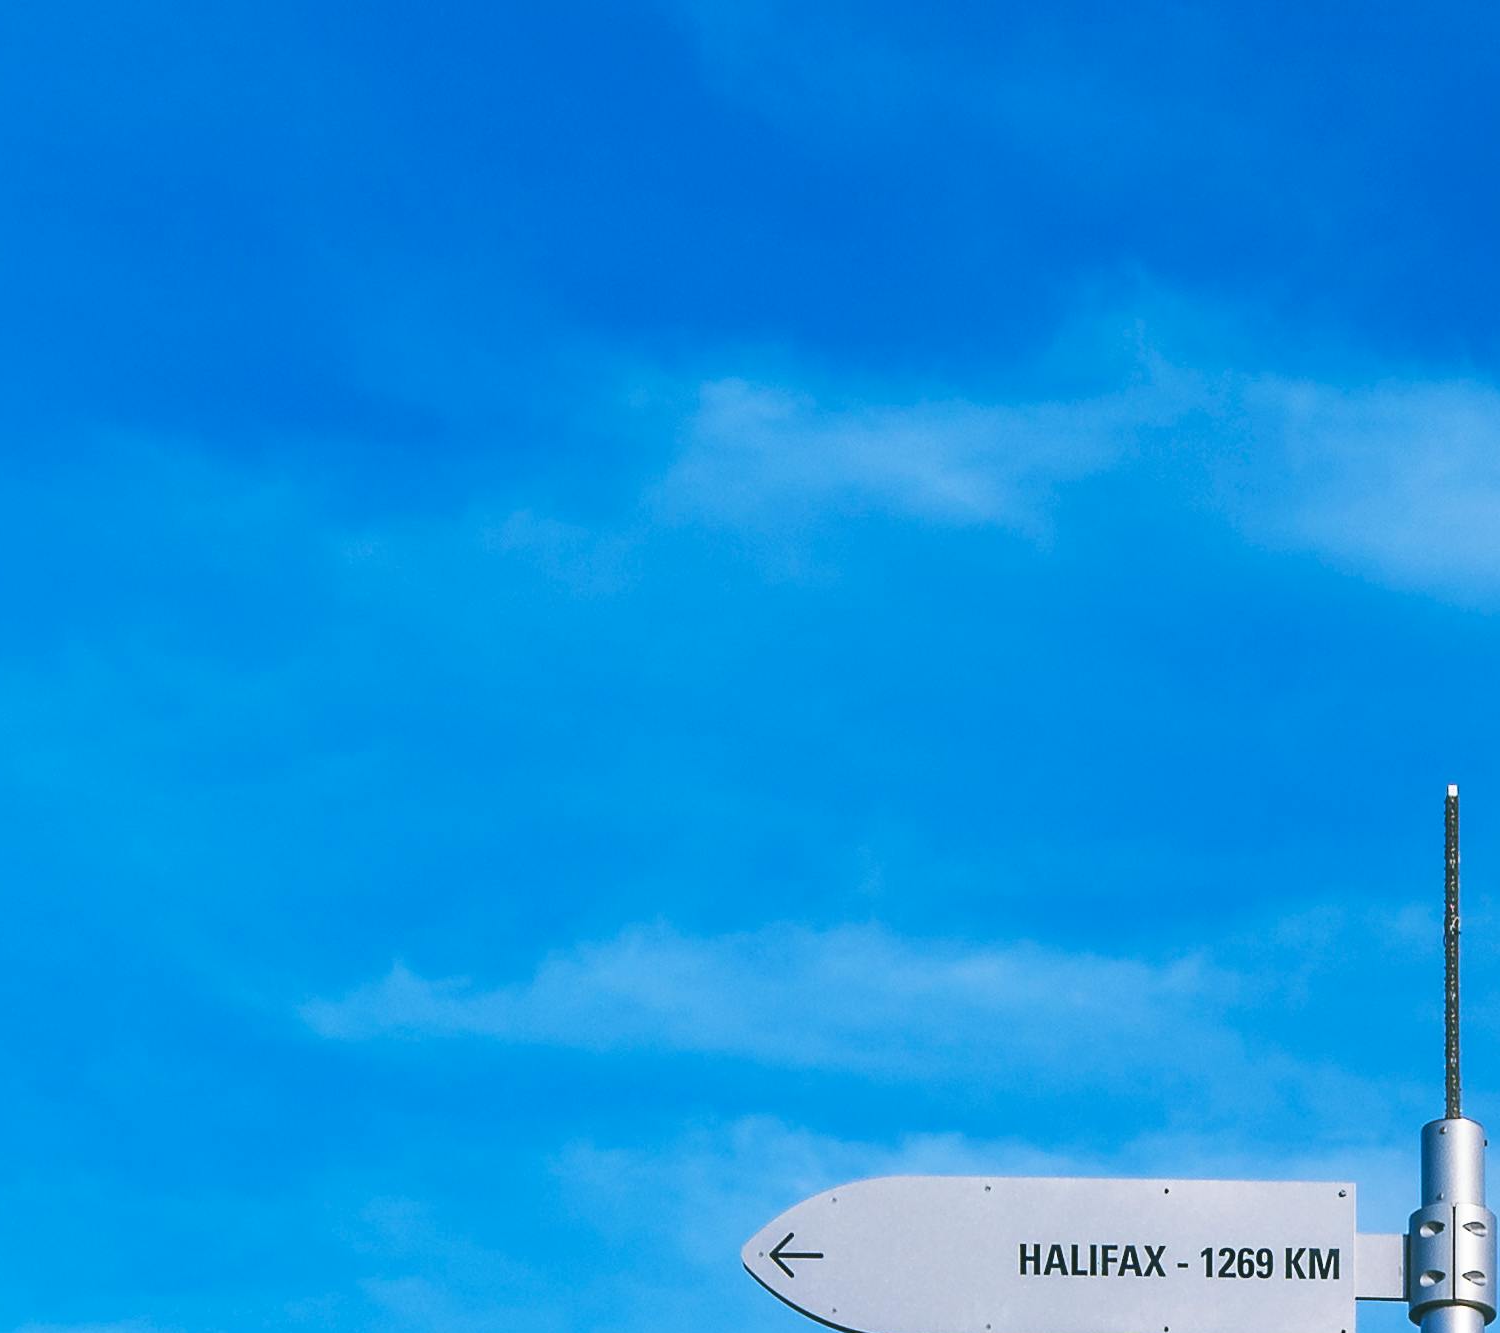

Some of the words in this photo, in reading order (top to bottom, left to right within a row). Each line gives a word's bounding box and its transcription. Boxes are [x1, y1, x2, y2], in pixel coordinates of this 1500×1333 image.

[1018, 1242, 1167, 1279] HALIFAX
[1199, 1246, 1275, 1280] 1269
[1284, 1246, 1341, 1281] KM
